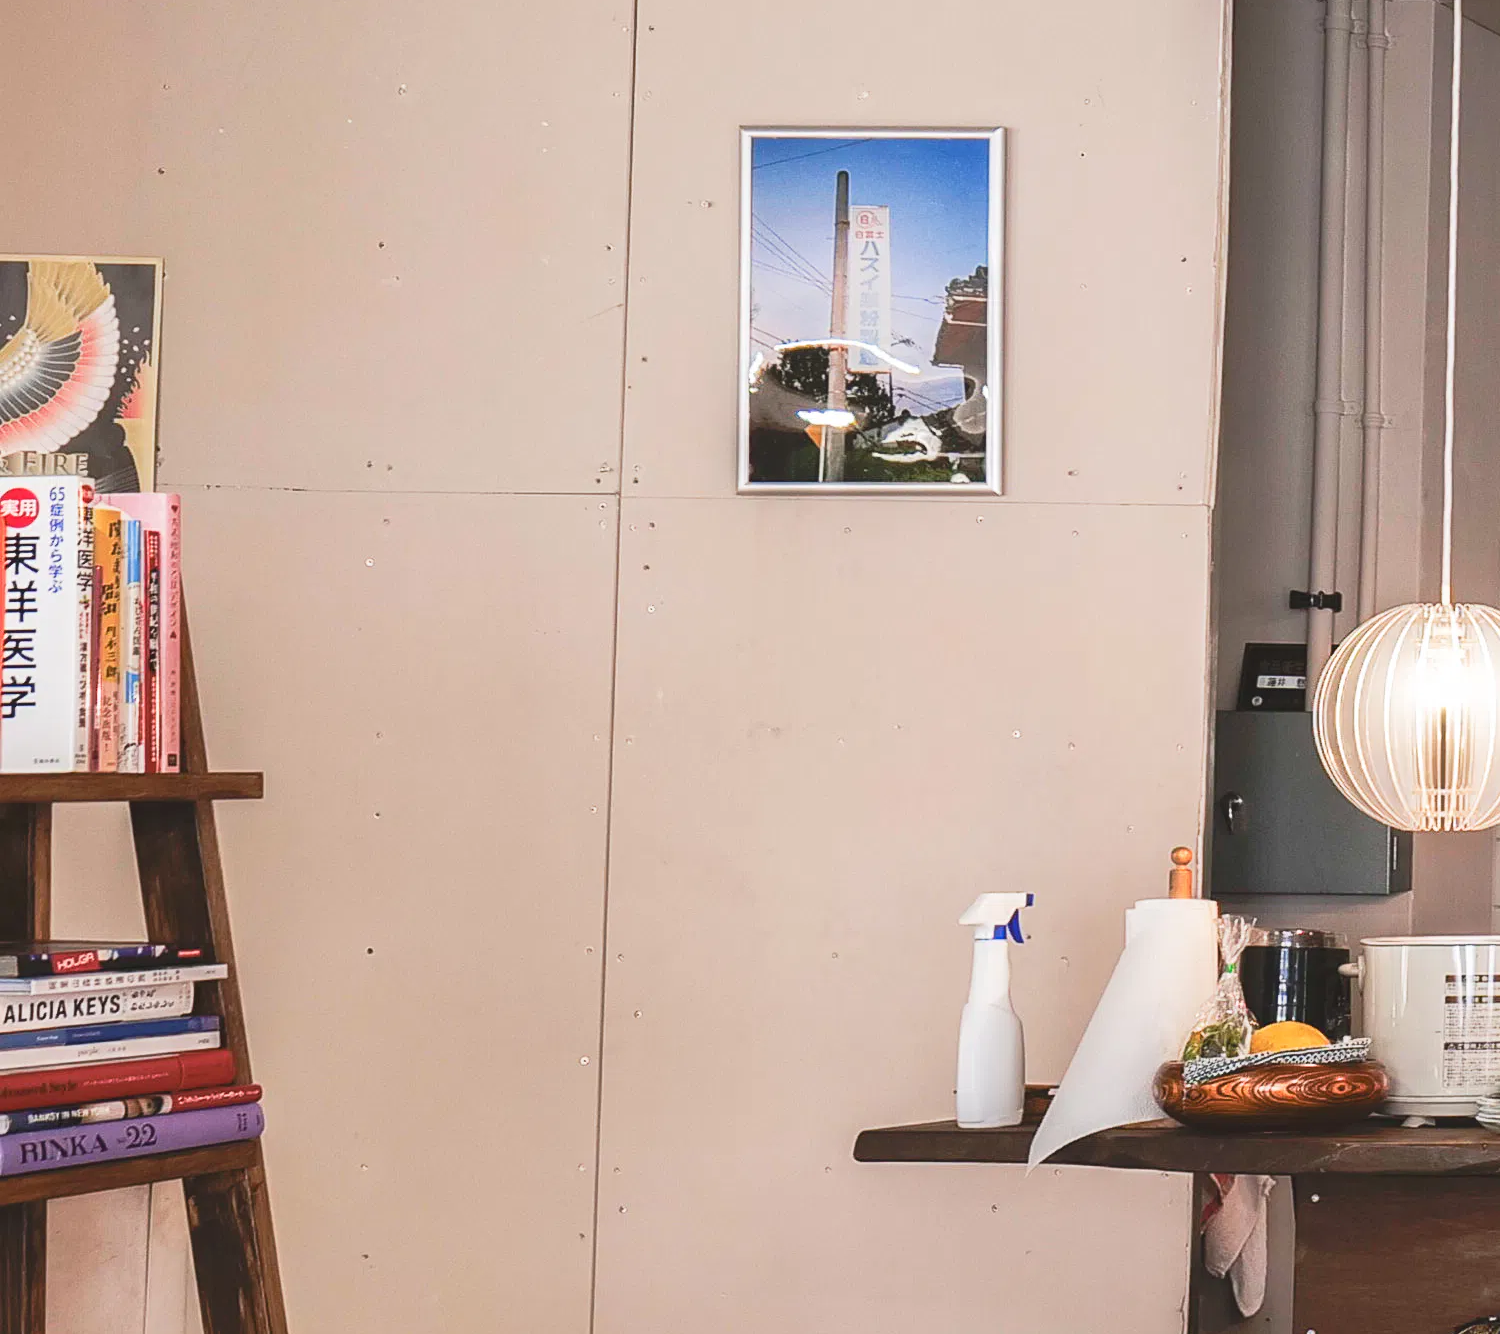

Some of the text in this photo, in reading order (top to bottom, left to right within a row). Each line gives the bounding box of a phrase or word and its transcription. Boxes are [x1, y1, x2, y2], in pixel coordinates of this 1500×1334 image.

[21, 452, 89, 476] FIRE
[0, 498, 37, 517] 実用
[47, 486, 65, 593] 65症例から学ぶ
[1, 533, 39, 720] 東洋医学
[4, 1000, 71, 1024] ALICIA
[73, 994, 121, 1017] KEYS
[61, 1110, 70, 1119] IN
[71, 1108, 89, 1118] NEW
[20, 1133, 108, 1164] RINKA
